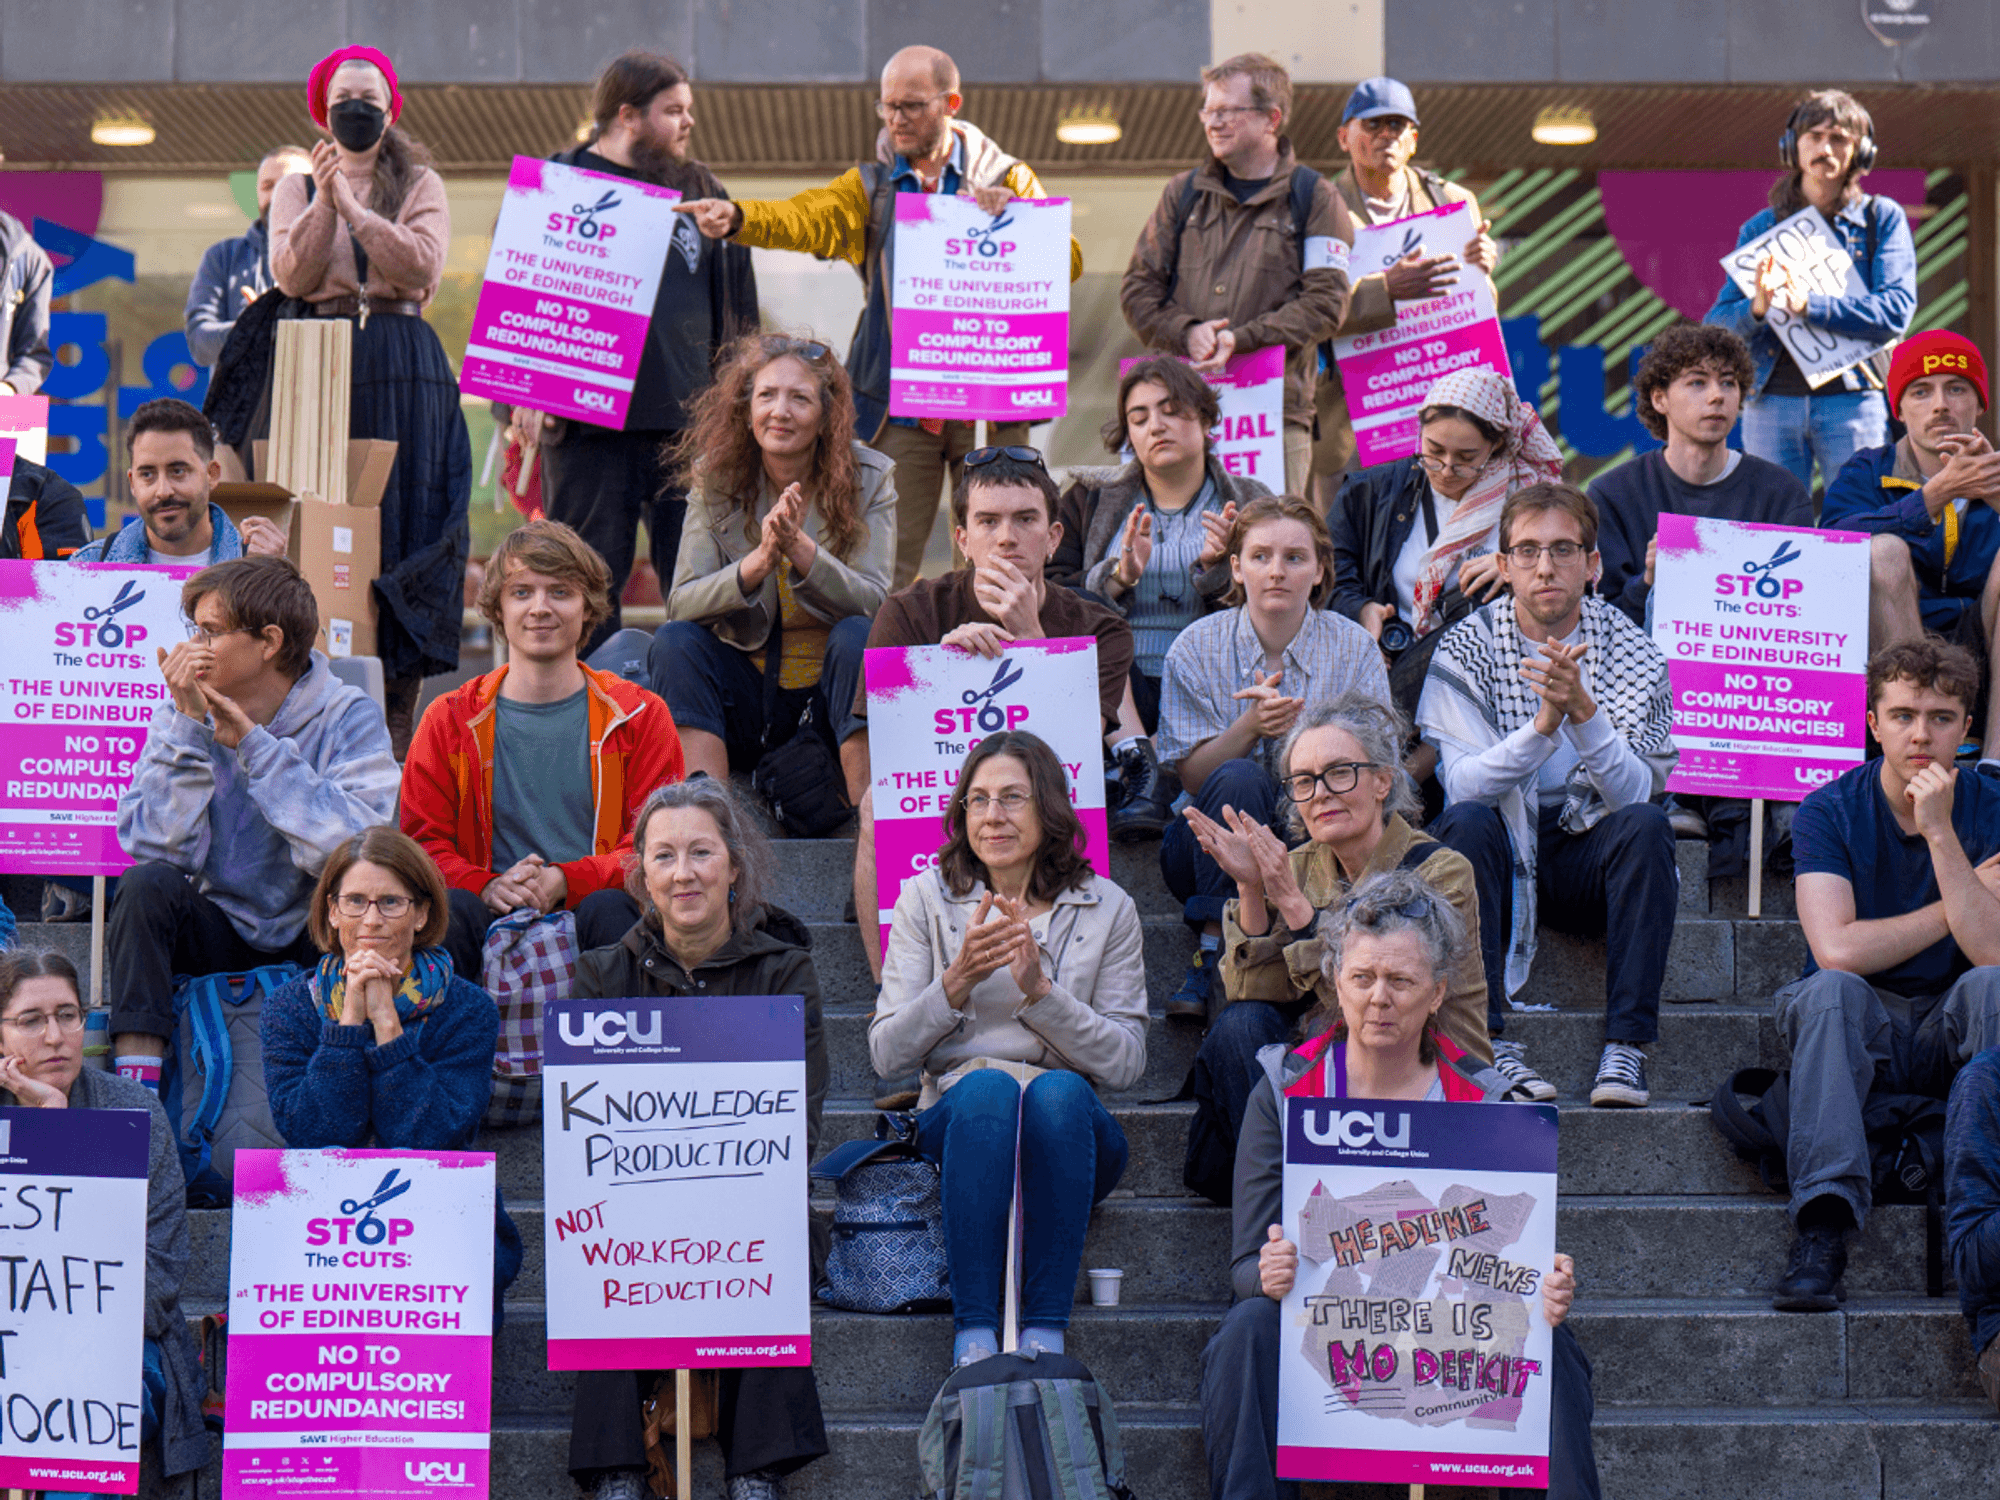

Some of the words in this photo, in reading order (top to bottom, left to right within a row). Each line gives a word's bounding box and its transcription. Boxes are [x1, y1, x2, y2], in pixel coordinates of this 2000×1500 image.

[546, 212, 617, 241] STOP
[543, 235, 563, 249] The
[945, 238, 1017, 257] STOP
[1735, 216, 1817, 272] STOP
[506, 249, 538, 267] THE
[542, 256, 643, 290] UNIVERSITY
[944, 259, 966, 270] The
[505, 268, 527, 283] OF
[532, 273, 633, 307] EDINBURGH
[910, 277, 943, 290] THE
[949, 279, 1053, 293] UNIVERSITY
[535, 299, 563, 317] NO
[566, 305, 590, 323] TO
[914, 294, 937, 305] OF
[943, 295, 1048, 310] EDINBURGH
[499, 310, 619, 349] COMPULSORY
[953, 318, 981, 332] NO
[984, 319, 1009, 333] TO
[1352, 334, 1375, 351] OF
[1379, 308, 1477, 344] EDINBURGH
[486, 325, 624, 370] REDUNDANCIES!
[918, 332, 1042, 350] COMPULSORY
[908, 349, 1052, 366] REDUNDANCIES!
[1394, 347, 1422, 366] NO
[1422, 340, 1448, 357] TO
[1923, 353, 1968, 374] pcs
[1367, 347, 1481, 390] COMPULSORY
[1715, 573, 1804, 600] STOP
[1714, 600, 1742, 613] The
[1745, 602, 1802, 618] CUTS:
[54, 621, 148, 648] STOP
[1672, 620, 1713, 637] THE
[1720, 625, 1848, 648] UNIVERSITY
[53, 652, 83, 667] The
[85, 653, 146, 669] CUTS:
[1676, 642, 1706, 657] OF
[1712, 644, 1842, 668] EDINBURGH
[8, 679, 53, 696] THE
[1724, 673, 1758, 690] NO
[1762, 676, 1793, 692] TO
[14, 702, 45, 719] OF
[52, 703, 153, 722] EDINBUR
[1681, 690, 1834, 716] COMPULSORY
[934, 704, 1029, 734] STOP
[65, 735, 99, 753] NO
[105, 737, 136, 754] TO
[934, 741, 965, 755] The
[20, 757, 138, 778] COMPULS
[892, 770, 937, 790] THE
[900, 794, 932, 813] OF
[558, 1010, 662, 1047] UCU
[560, 1080, 799, 1131] KNOWLEDGE
[1303, 1109, 1411, 1148] UCU
[585, 1133, 791, 1177] PRODUCTION
[555, 1200, 607, 1241] NOT
[305, 1217, 415, 1246] STOP
[1329, 1199, 1491, 1267] HEADLINE
[305, 1253, 339, 1268] The
[342, 1251, 412, 1268] CUTS:
[581, 1237, 765, 1266] WORKFORCE
[1448, 1248, 1541, 1295] NEWS
[236, 1288, 249, 1299] at
[253, 1284, 304, 1302] THE
[312, 1284, 469, 1303] UNIVERSITY
[603, 1273, 772, 1308] REDUCTION
[259, 1310, 295, 1328] OF
[303, 1310, 460, 1329] EDINBURGH
[1304, 1295, 1433, 1335] THERE
[1452, 1303, 1494, 1341] IS
[318, 1345, 358, 1365] NO
[365, 1345, 401, 1365] TO
[695, 1344, 797, 1357] www.ucu.org.uk
[1327, 1339, 1398, 1389] NO
[1412, 1348, 1542, 1398] DEFICIT
[266, 1372, 452, 1392] COMPULSORY
[251, 1398, 465, 1420] REDUNDANCIES!
[300, 1434, 327, 1444] SAVE
[330, 1434, 362, 1445] Higher
[365, 1434, 414, 1444] Education
[29, 1467, 126, 1483] www.ucu.org.uk
[405, 1462, 465, 1483] UCU
[1430, 1462, 1534, 1476] www.ucu.org.uk
